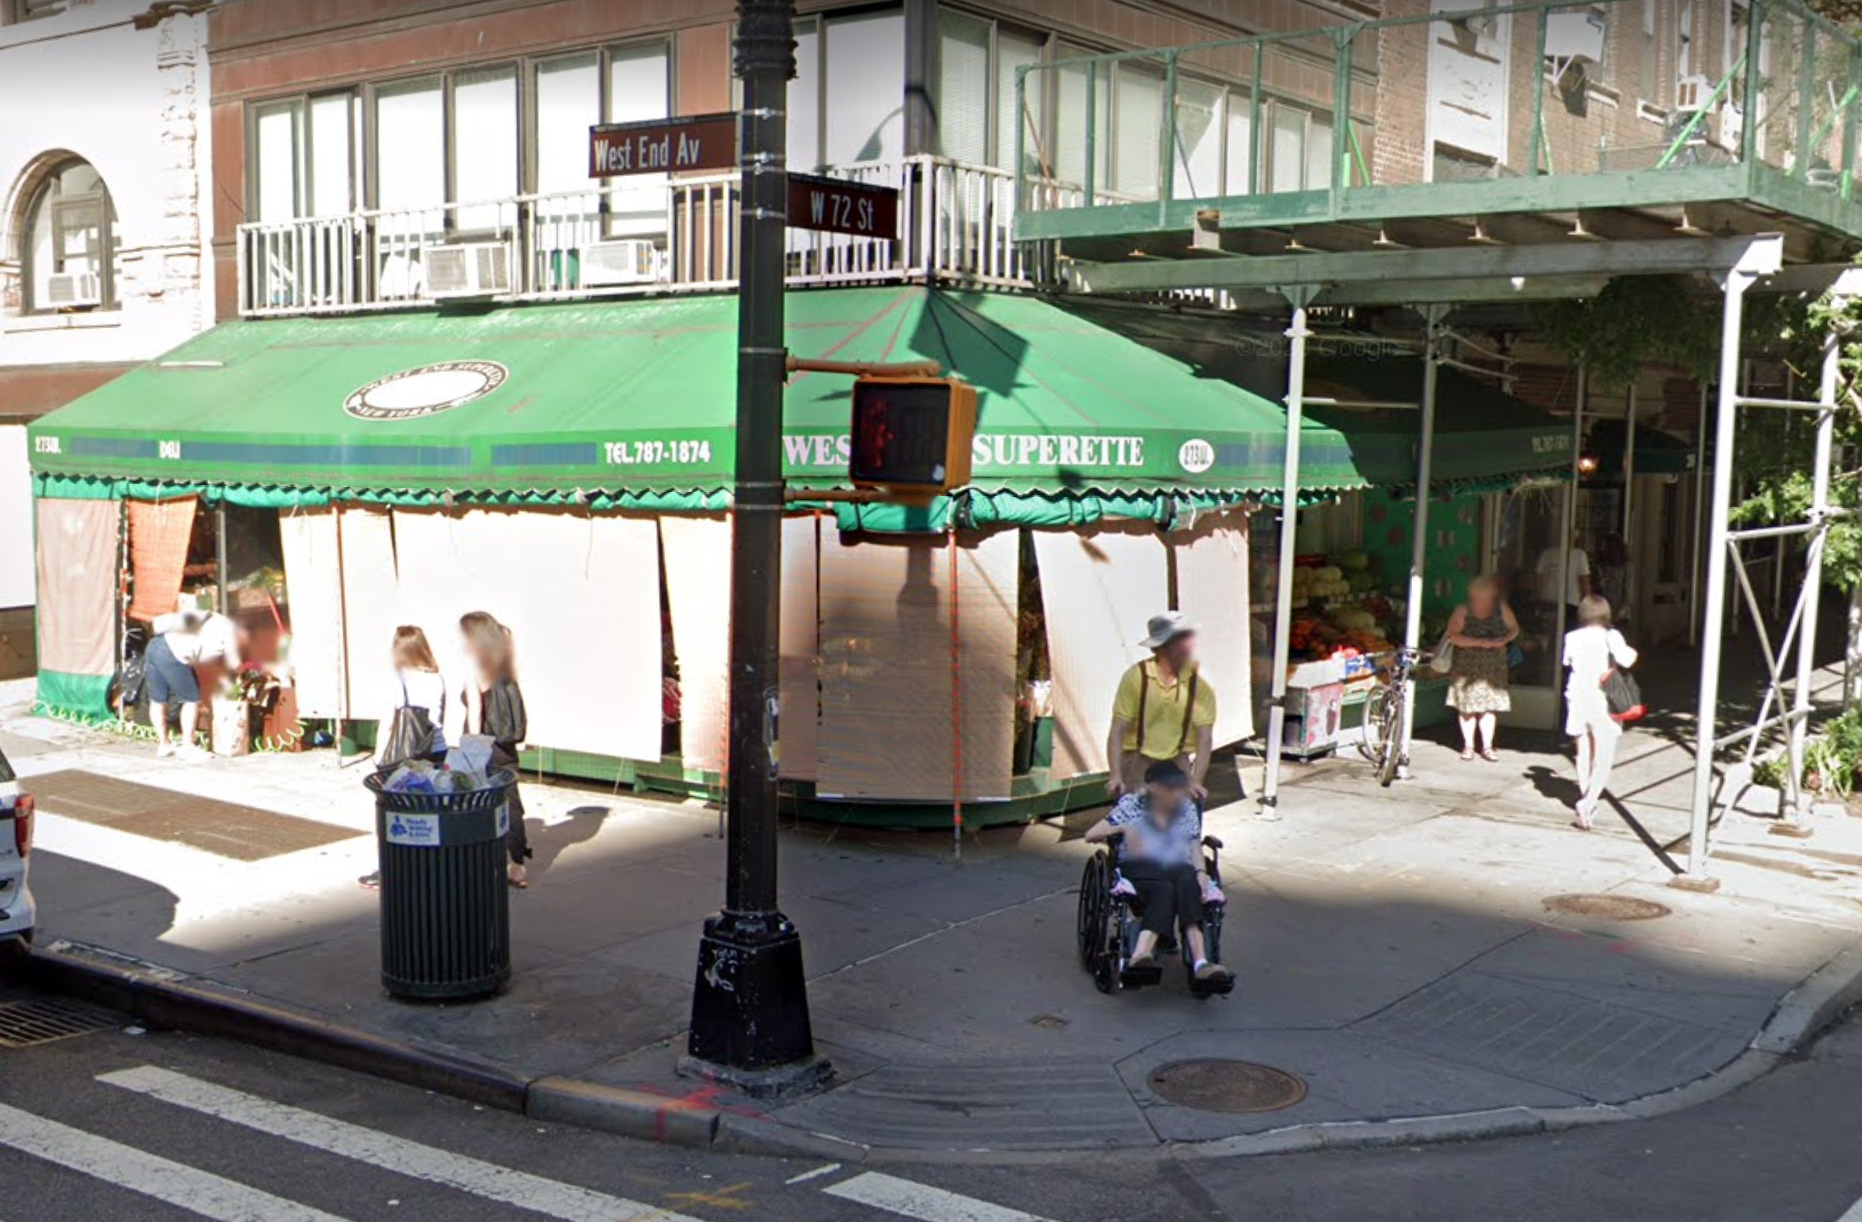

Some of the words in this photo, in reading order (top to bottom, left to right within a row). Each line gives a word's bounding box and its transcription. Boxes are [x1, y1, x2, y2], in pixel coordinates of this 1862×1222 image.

[594, 138, 632, 171] West
[638, 134, 669, 168] End
[676, 132, 700, 165] Av
[811, 191, 825, 225] W
[830, 194, 851, 228] 72
[858, 198, 874, 231] St
[604, 440, 711, 464] TEL.787-1874
[781, 434, 852, 466] WES
[971, 434, 1144, 466] SUPERETTE
